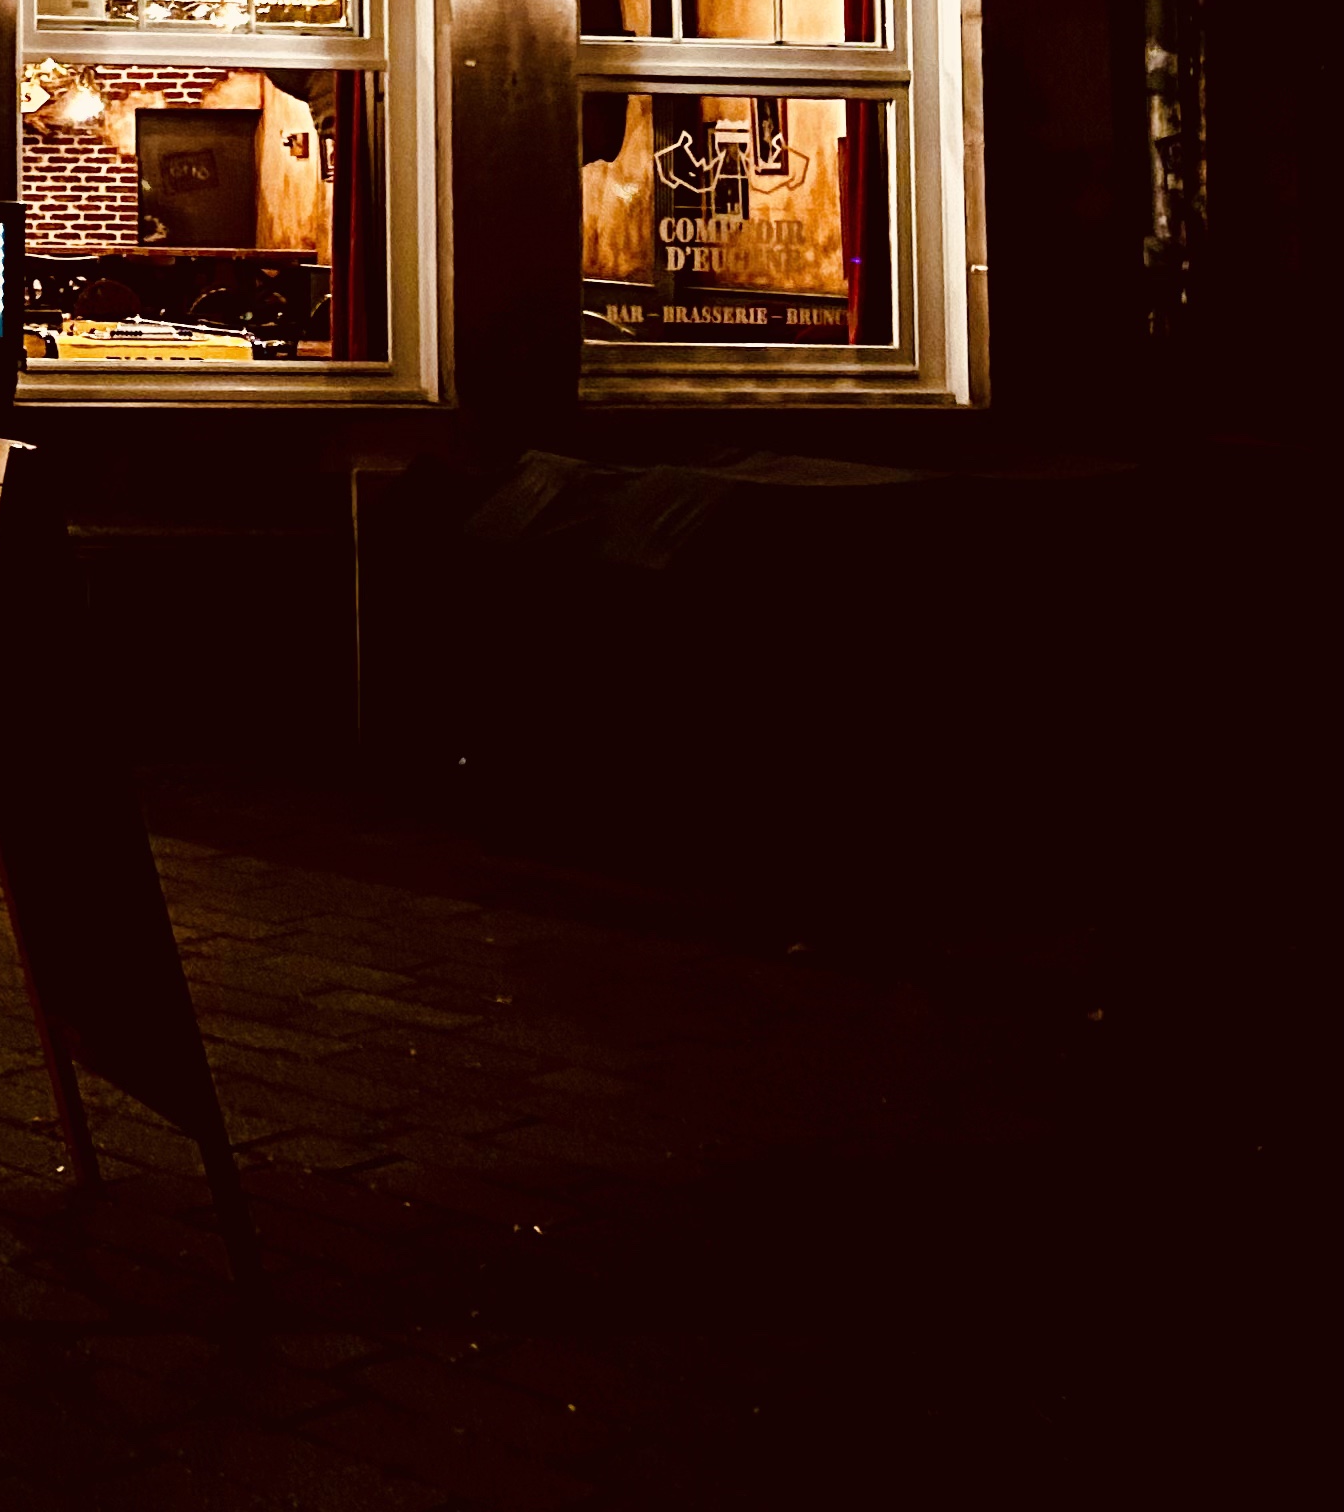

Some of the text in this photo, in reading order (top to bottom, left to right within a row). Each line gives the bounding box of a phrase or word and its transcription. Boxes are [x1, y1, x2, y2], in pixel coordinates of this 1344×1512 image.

[659, 217, 806, 245] COMPOIR
[605, 304, 853, 326] BAR BRASSERIE BRUNC
